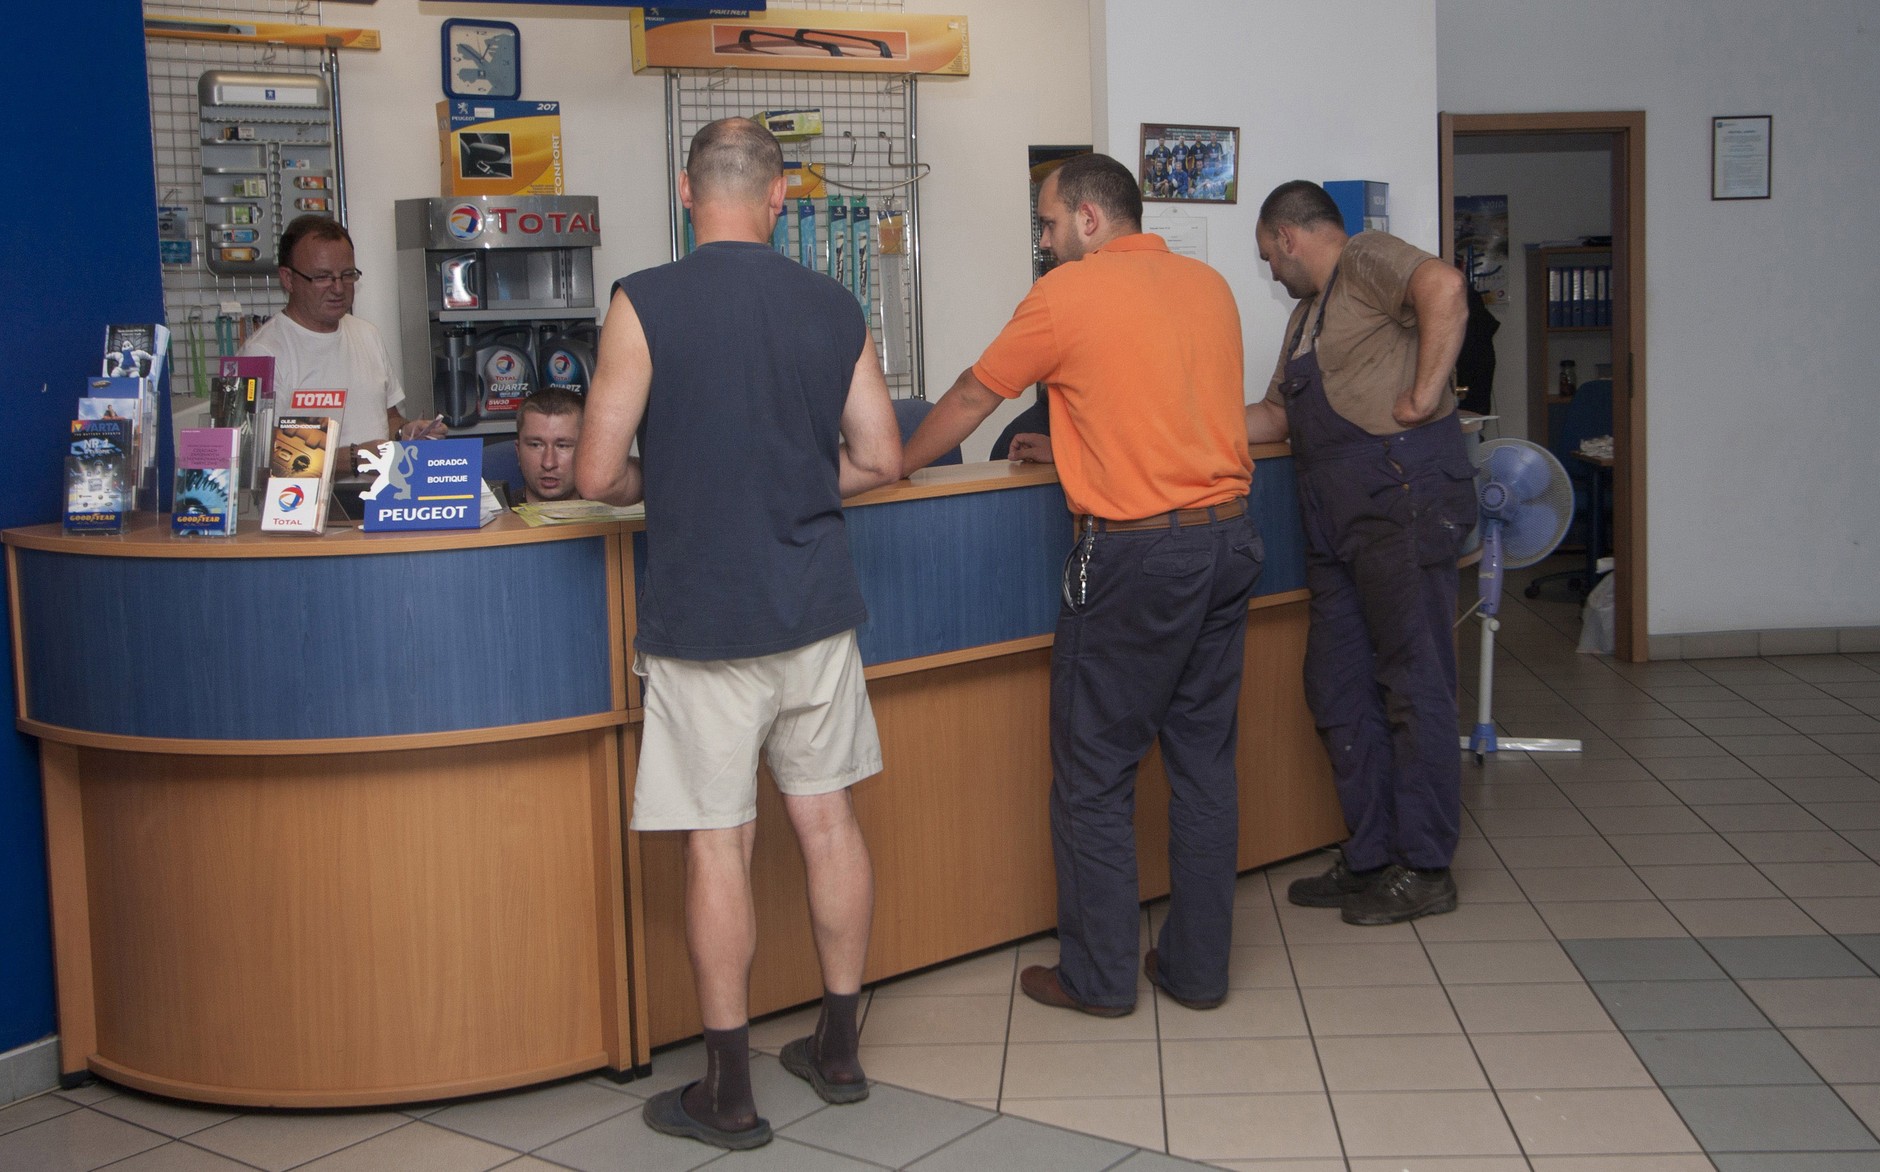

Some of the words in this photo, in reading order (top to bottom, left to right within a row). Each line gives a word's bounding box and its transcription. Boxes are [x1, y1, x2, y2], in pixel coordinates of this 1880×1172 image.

[536, 103, 557, 112] 207
[552, 134, 562, 196] CONFORT
[488, 207, 600, 234] TOTAL
[490, 383, 529, 392] QUARTZ
[295, 394, 342, 407] TOTAL
[428, 458, 468, 467] DORADCA
[427, 475, 468, 484] BOUTIQUE
[69, 514, 116, 522] GOODYEAR
[378, 506, 468, 522] PEUGEOT
[176, 515, 220, 523] GOODYEAR
[272, 518, 303, 526] TOTAL
